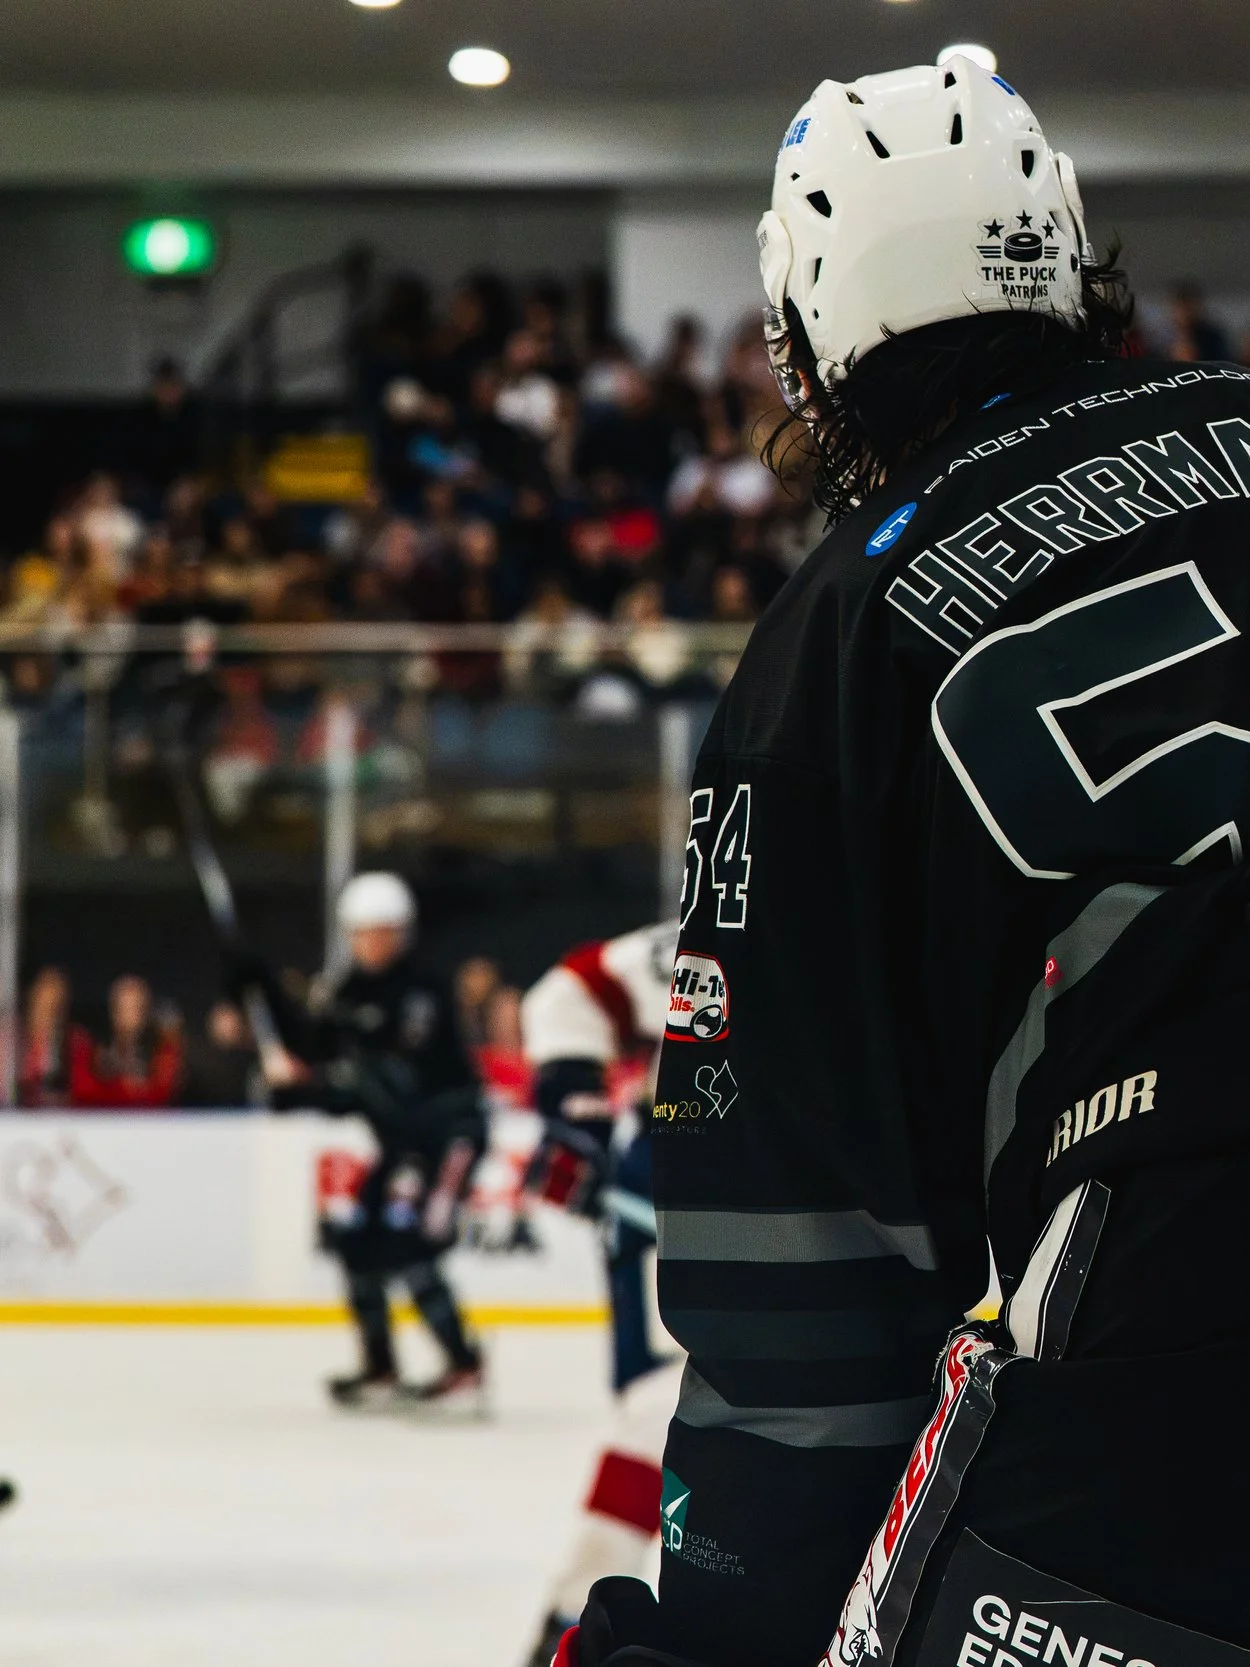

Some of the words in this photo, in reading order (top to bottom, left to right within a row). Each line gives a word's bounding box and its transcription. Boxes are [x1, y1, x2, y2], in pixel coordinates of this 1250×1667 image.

[981, 266, 1016, 281] THE
[1019, 266, 1057, 282] PUCK
[1001, 284, 1049, 299] PATRONS
[870, 509, 909, 548] RT
[1045, 1069, 1158, 1168] RIOR
[684, 1531, 721, 1551] TOTAL
[682, 1553, 746, 1576] PROJECTS
[683, 1543, 742, 1565] CONCEPT
